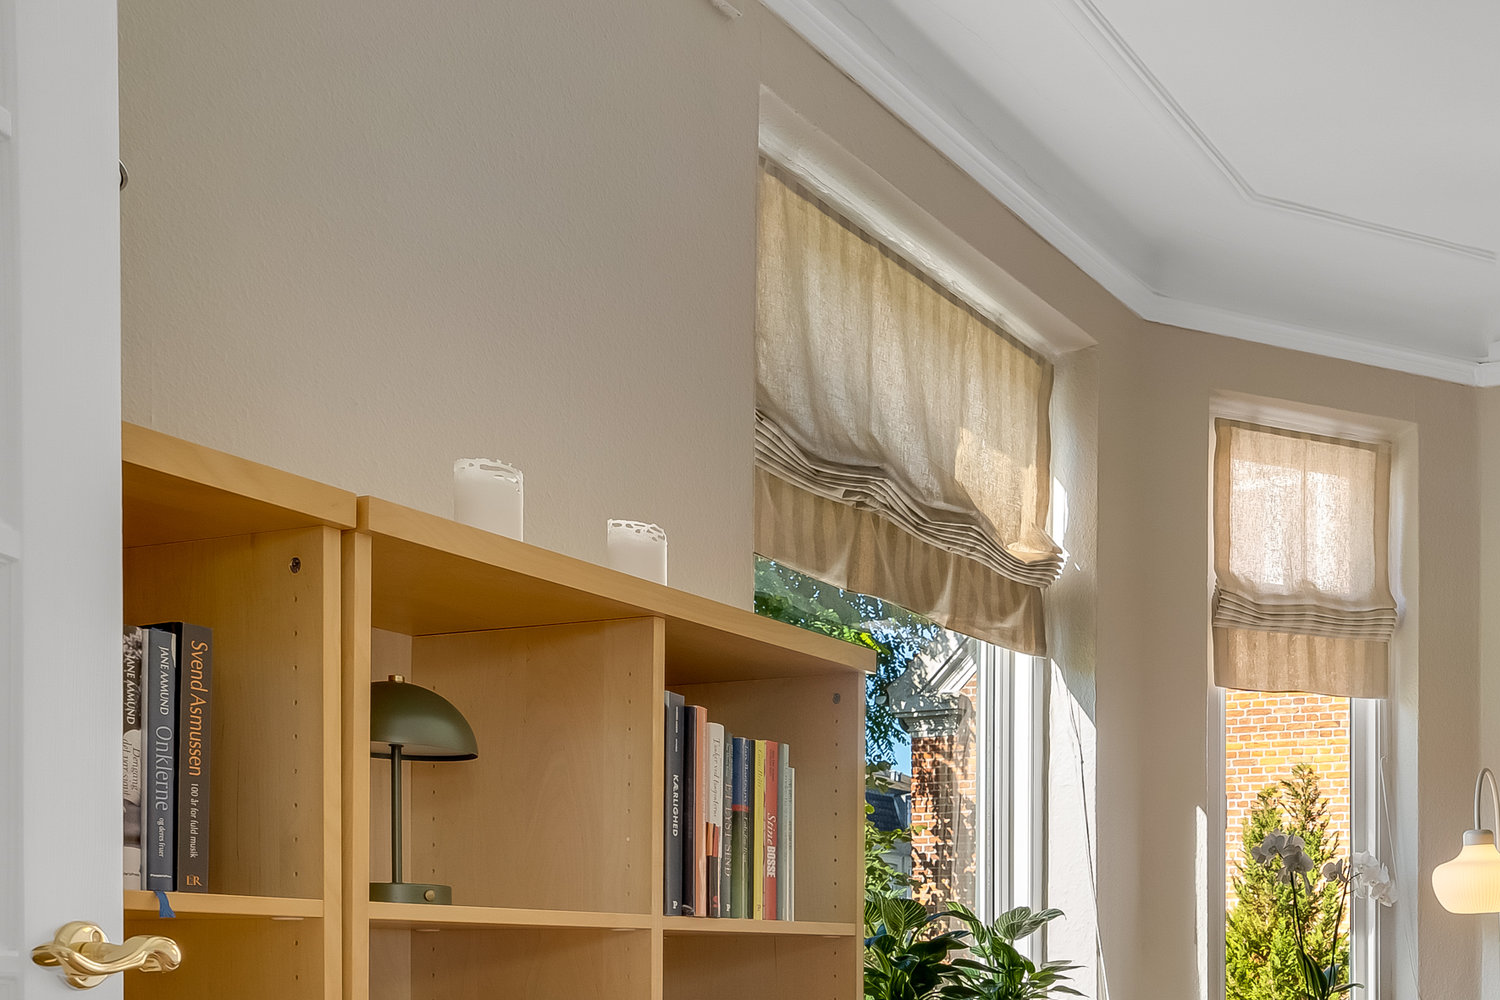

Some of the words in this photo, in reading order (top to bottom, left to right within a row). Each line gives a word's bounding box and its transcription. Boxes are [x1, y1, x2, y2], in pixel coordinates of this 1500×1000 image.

[159, 646, 170, 670] JANE
[190, 640, 208, 692] Svend
[160, 670, 170, 715] AAMUND
[188, 692, 208, 776] Asmussen
[155, 726, 174, 811] Onklerne
[190, 783, 199, 797] 100
[190, 798, 199, 806] år
[672, 774, 680, 837] KÆRLIGHED
[190, 808, 199, 818] for
[190, 820, 198, 835] fuld
[766, 812, 776, 846] Stine
[190, 836, 199, 858] musik
[766, 846, 776, 878] BOSSE
